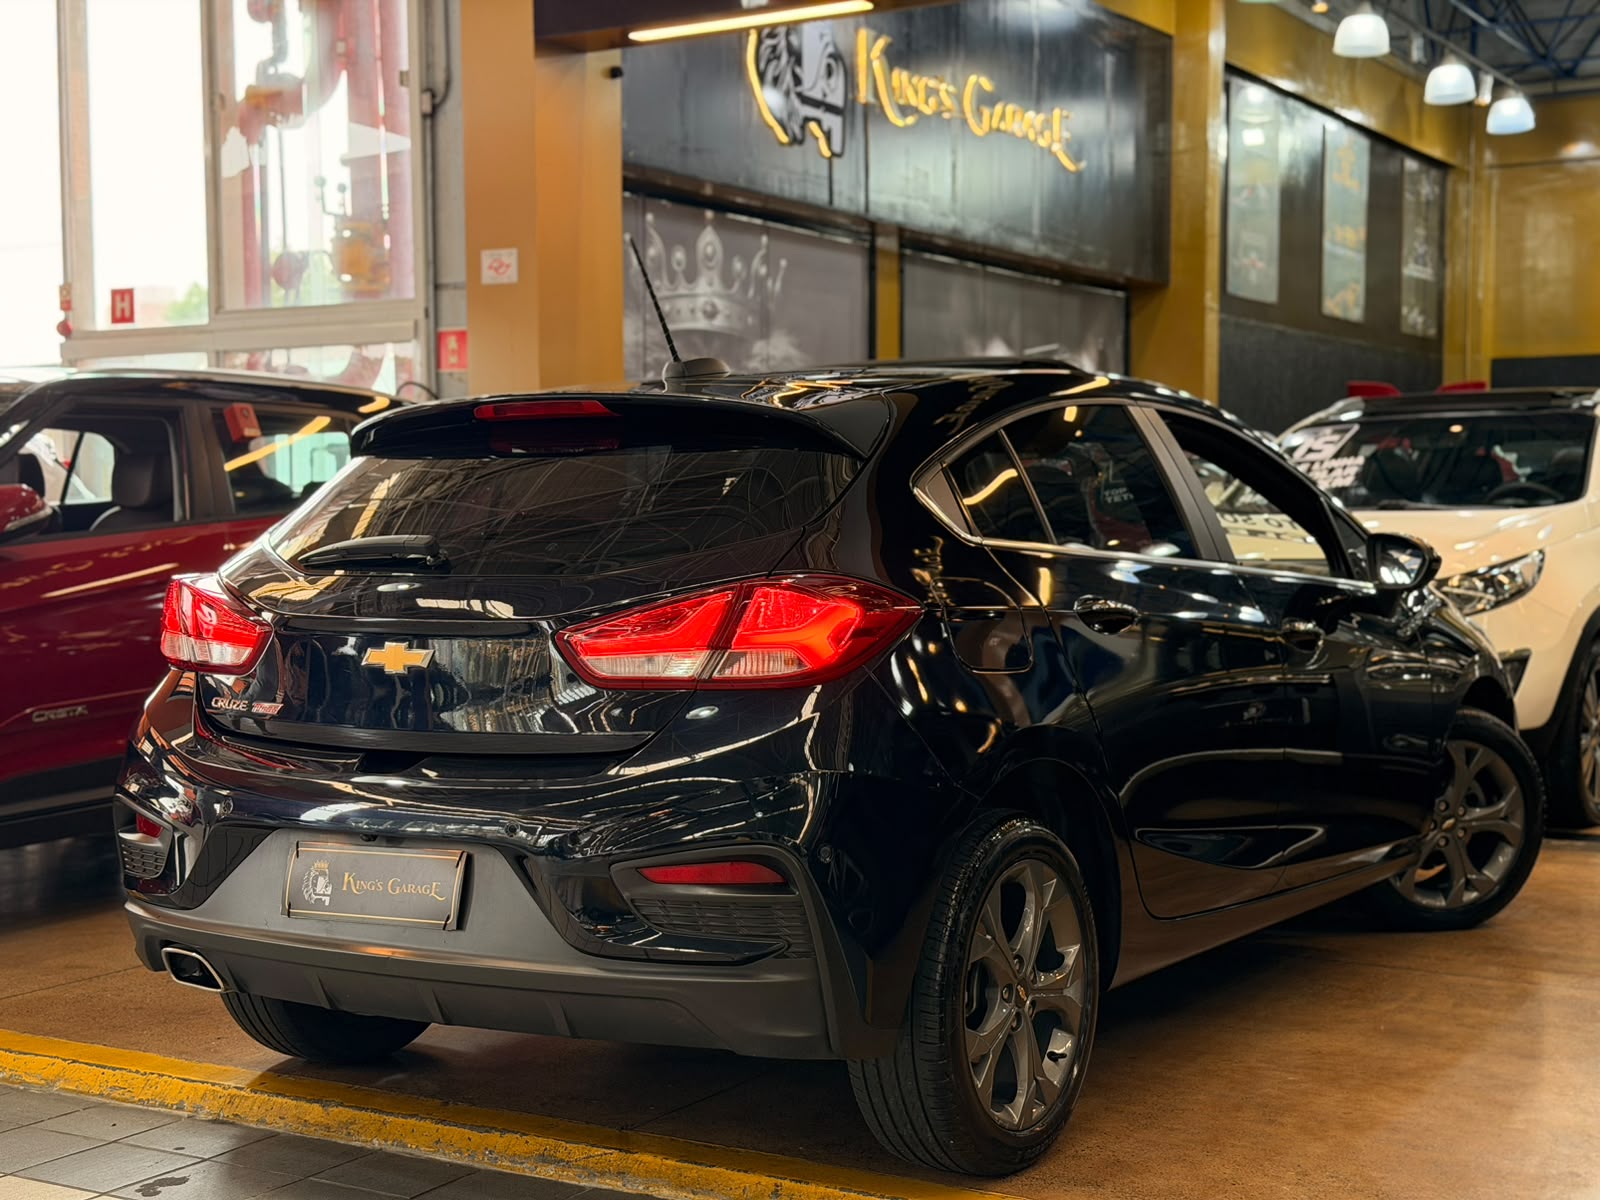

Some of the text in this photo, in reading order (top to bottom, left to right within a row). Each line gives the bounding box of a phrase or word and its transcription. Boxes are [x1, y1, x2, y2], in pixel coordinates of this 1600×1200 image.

[211, 696, 248, 711] CRUZE
[342, 872, 446, 901] KING'S GARAGE
